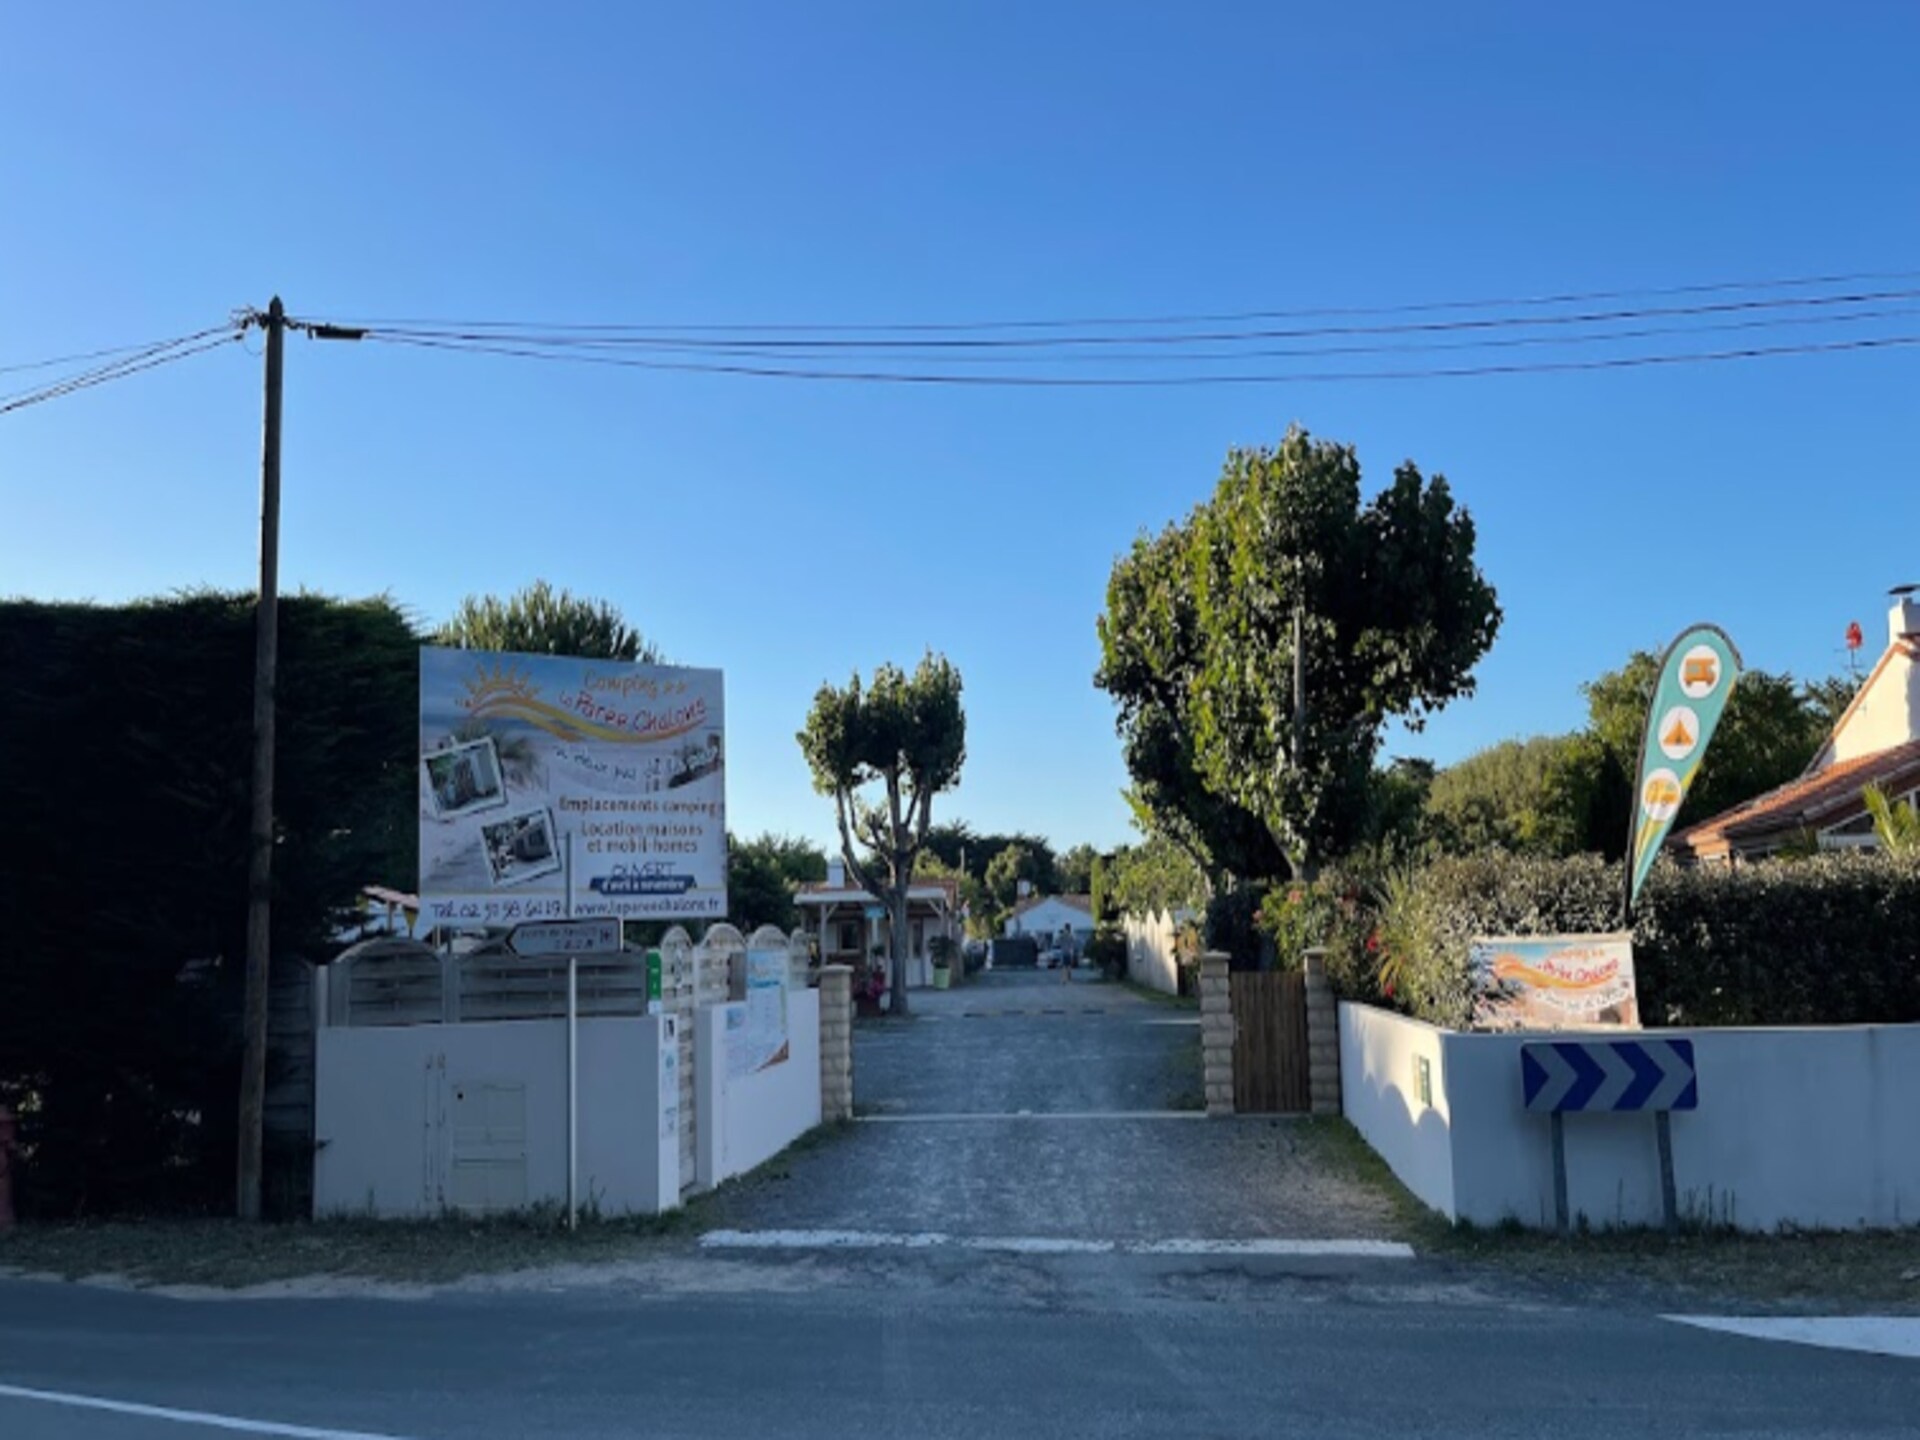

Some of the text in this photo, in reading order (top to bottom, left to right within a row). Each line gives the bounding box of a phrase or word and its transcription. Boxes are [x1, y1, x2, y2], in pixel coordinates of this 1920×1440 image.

[584, 668, 657, 700] Camping
[559, 795, 717, 819] Emplacements camping
[582, 820, 704, 837] Location maisons
[587, 839, 601, 852] et
[612, 861, 676, 879] OUVERT
